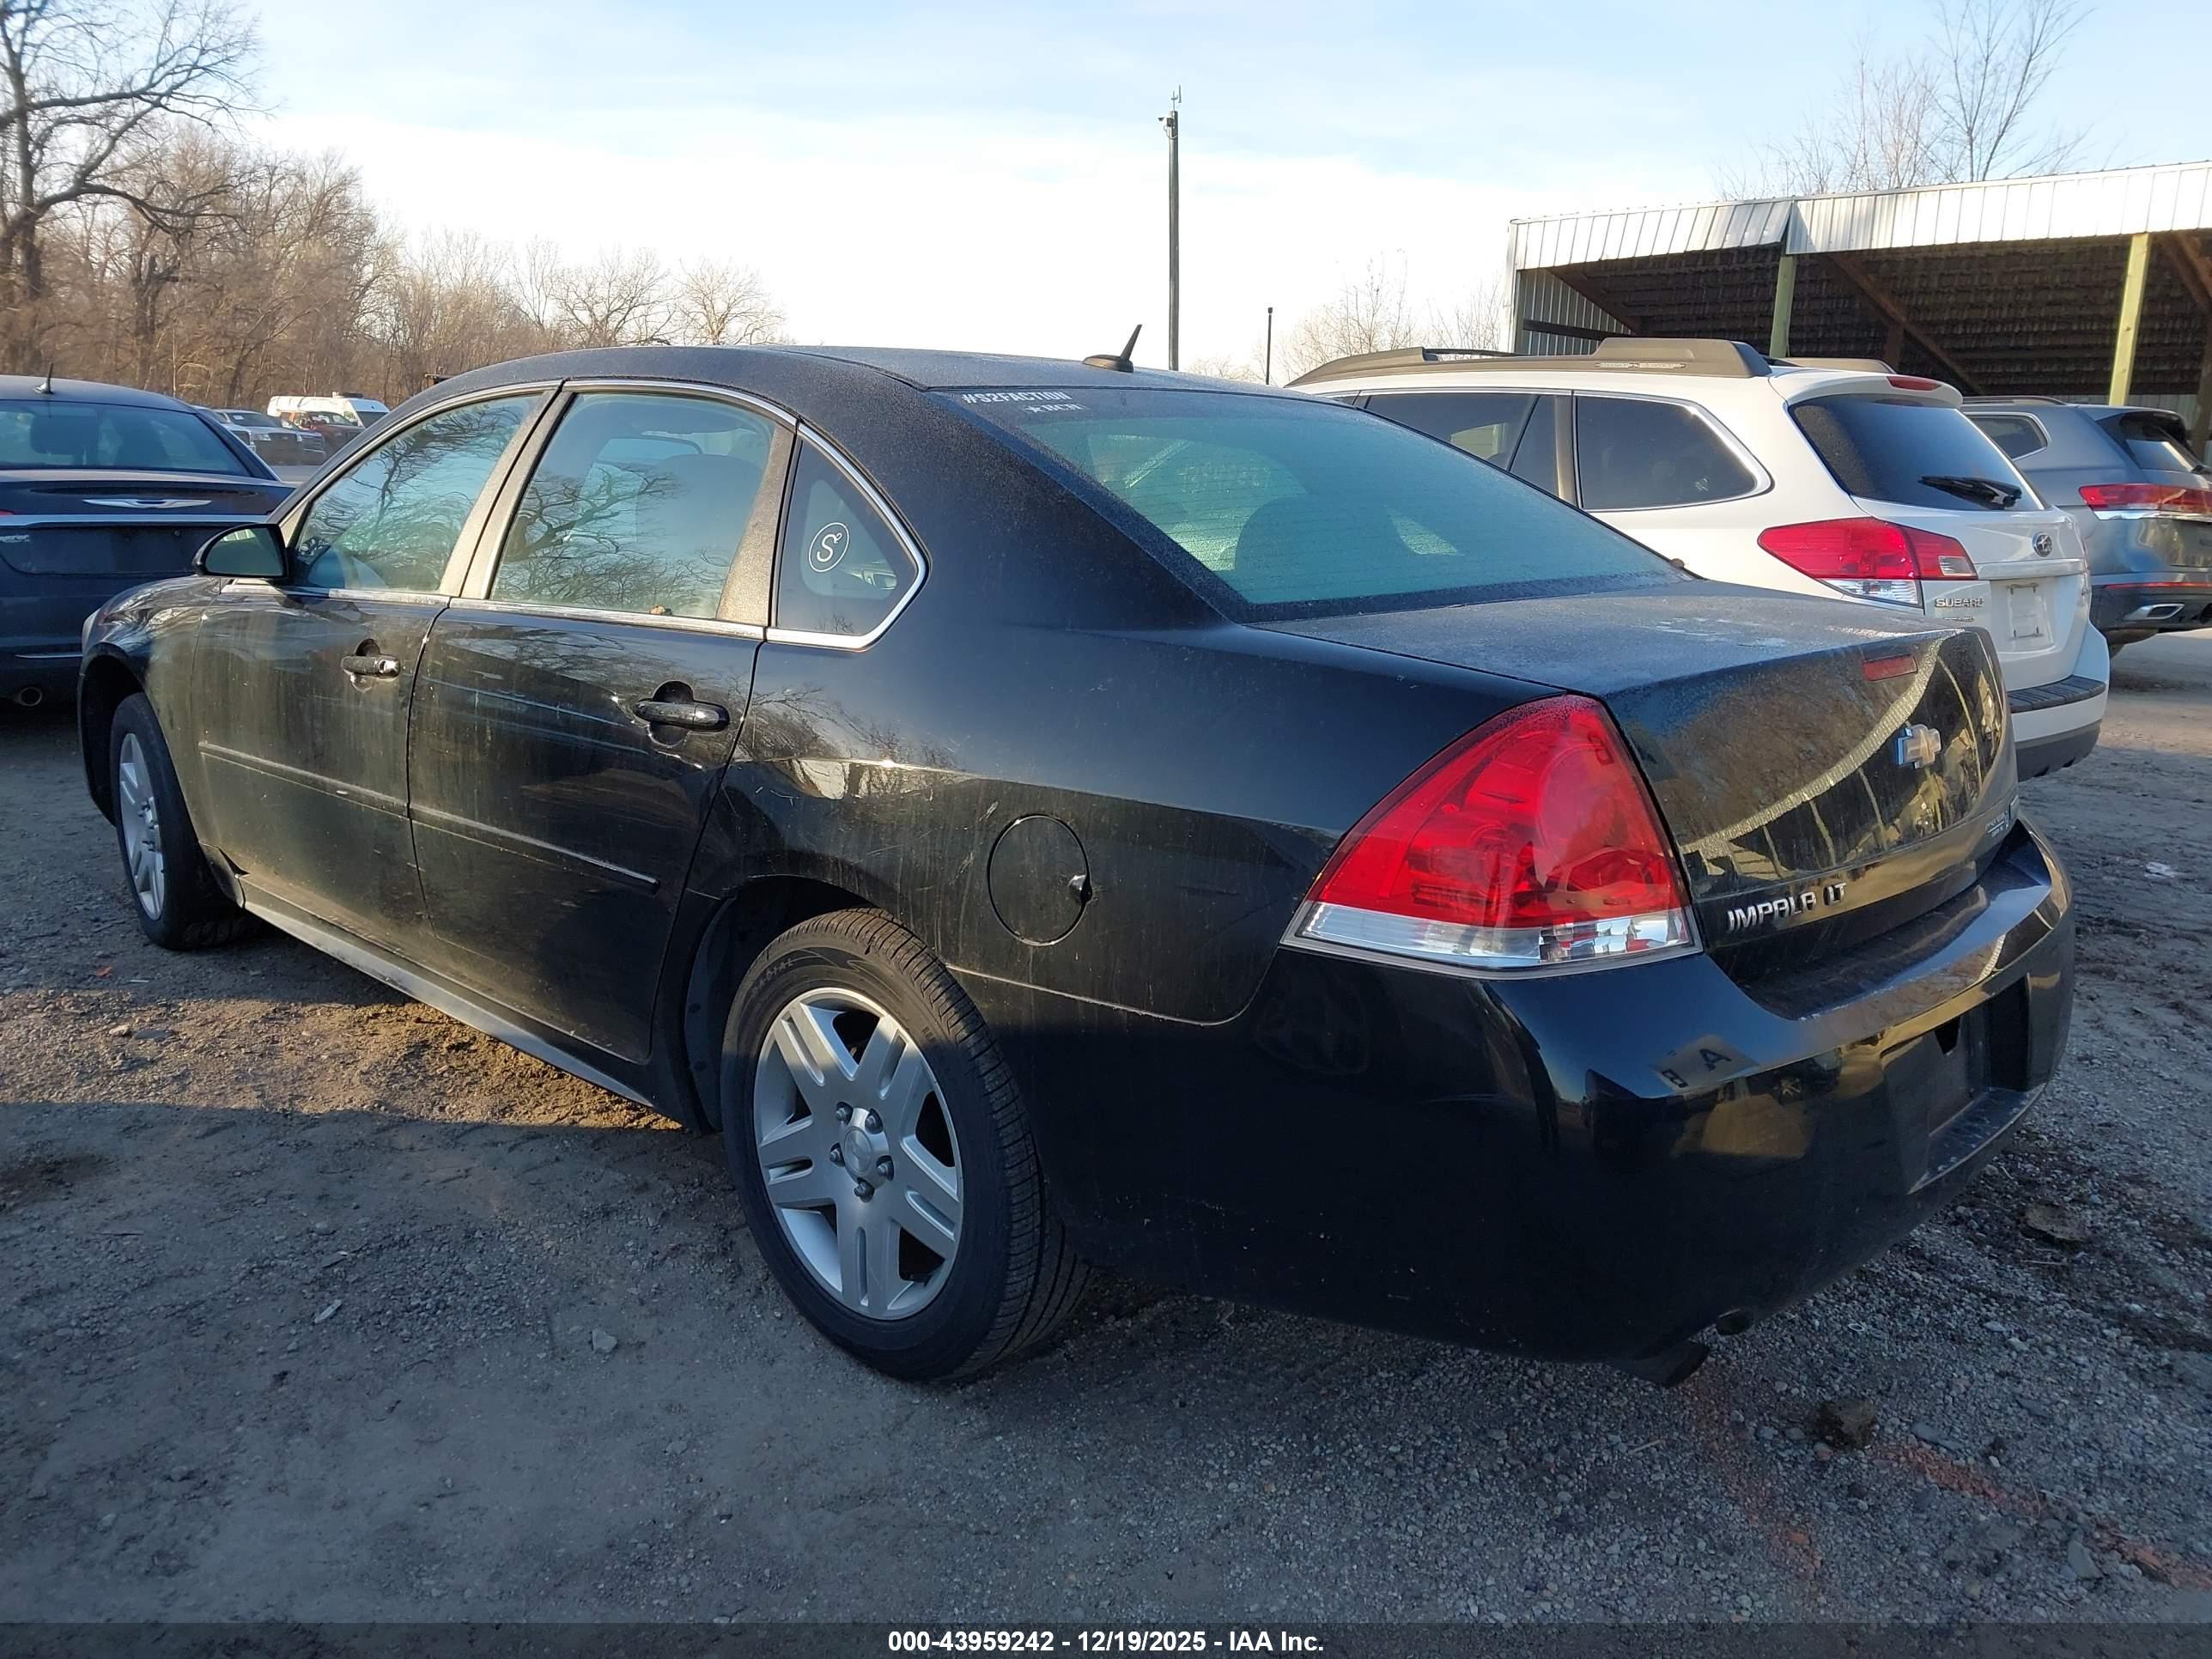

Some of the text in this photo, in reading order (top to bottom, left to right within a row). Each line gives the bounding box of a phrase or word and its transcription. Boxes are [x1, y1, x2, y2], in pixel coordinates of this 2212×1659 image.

[962, 391, 1073, 404] #S2FACTION
[1936, 597, 1984, 608] SUBARU
[1728, 882, 1846, 932] IMPALA LT
